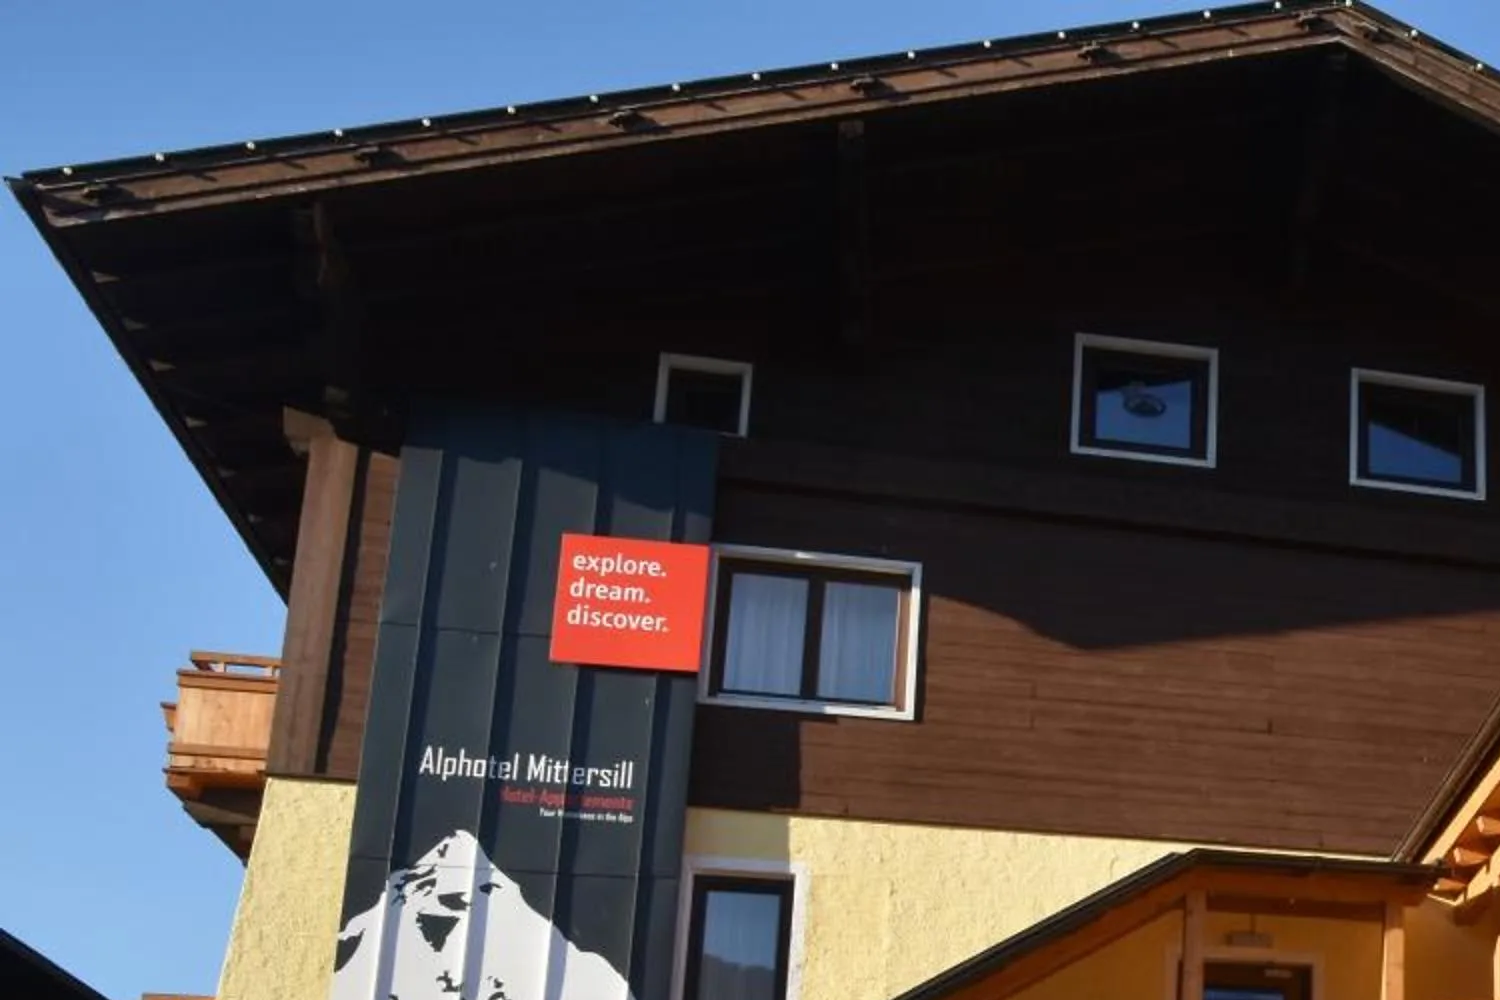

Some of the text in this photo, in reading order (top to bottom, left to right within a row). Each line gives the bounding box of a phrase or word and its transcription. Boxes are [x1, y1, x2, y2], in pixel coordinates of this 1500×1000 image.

[572, 551, 667, 577] explore.
[569, 576, 651, 604] dream.
[567, 603, 670, 633] discover.
[419, 744, 634, 789] Alphotel Mittersill
